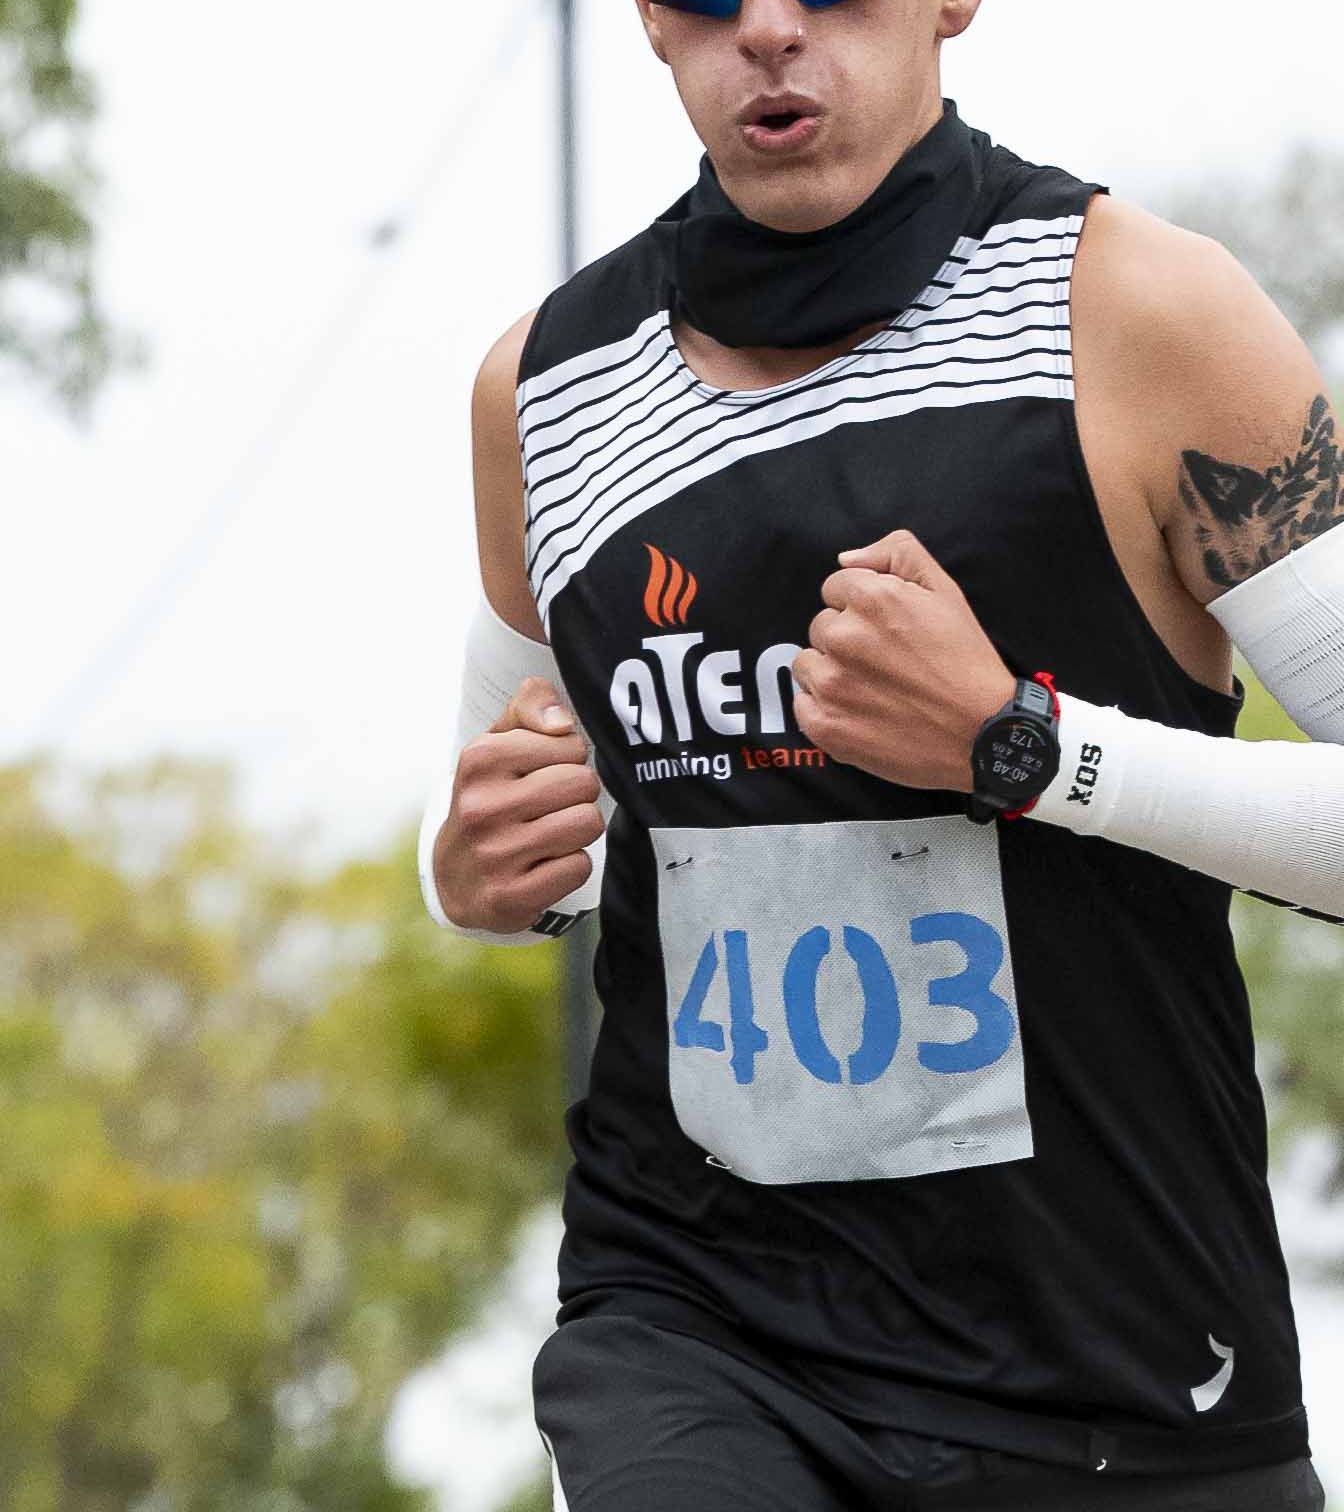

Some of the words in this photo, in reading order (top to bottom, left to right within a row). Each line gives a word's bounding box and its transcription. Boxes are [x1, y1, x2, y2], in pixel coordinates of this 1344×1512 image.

[635, 751, 732, 783] running
[741, 746, 826, 770] team
[1066, 743, 1103, 805] SOX
[673, 911, 1018, 1086] 403
